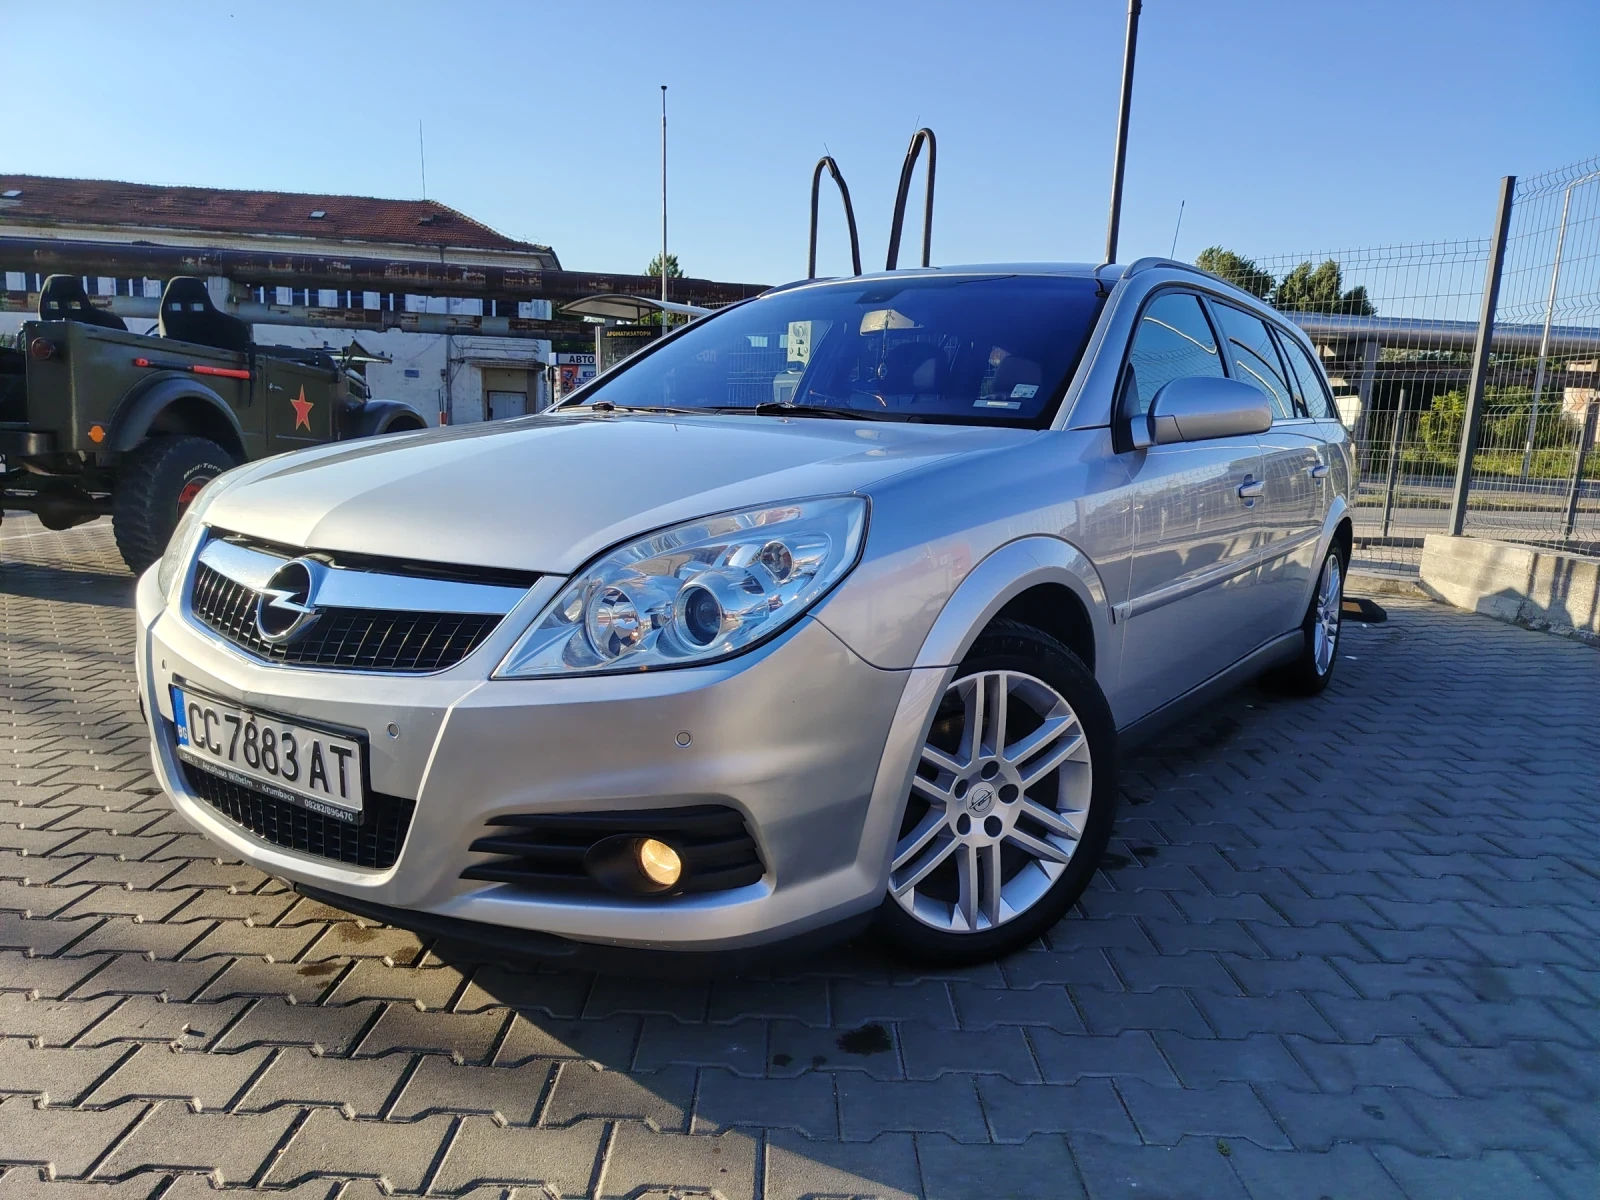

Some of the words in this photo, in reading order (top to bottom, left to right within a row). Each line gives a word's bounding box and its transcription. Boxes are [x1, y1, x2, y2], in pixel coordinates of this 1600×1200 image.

[569, 355, 595, 364] АВТО
[178, 725, 188, 740] BG
[202, 761, 228, 778] Autohaus
[228, 771, 253, 787] Wilhelm
[261, 783, 295, 802] Krumbach
